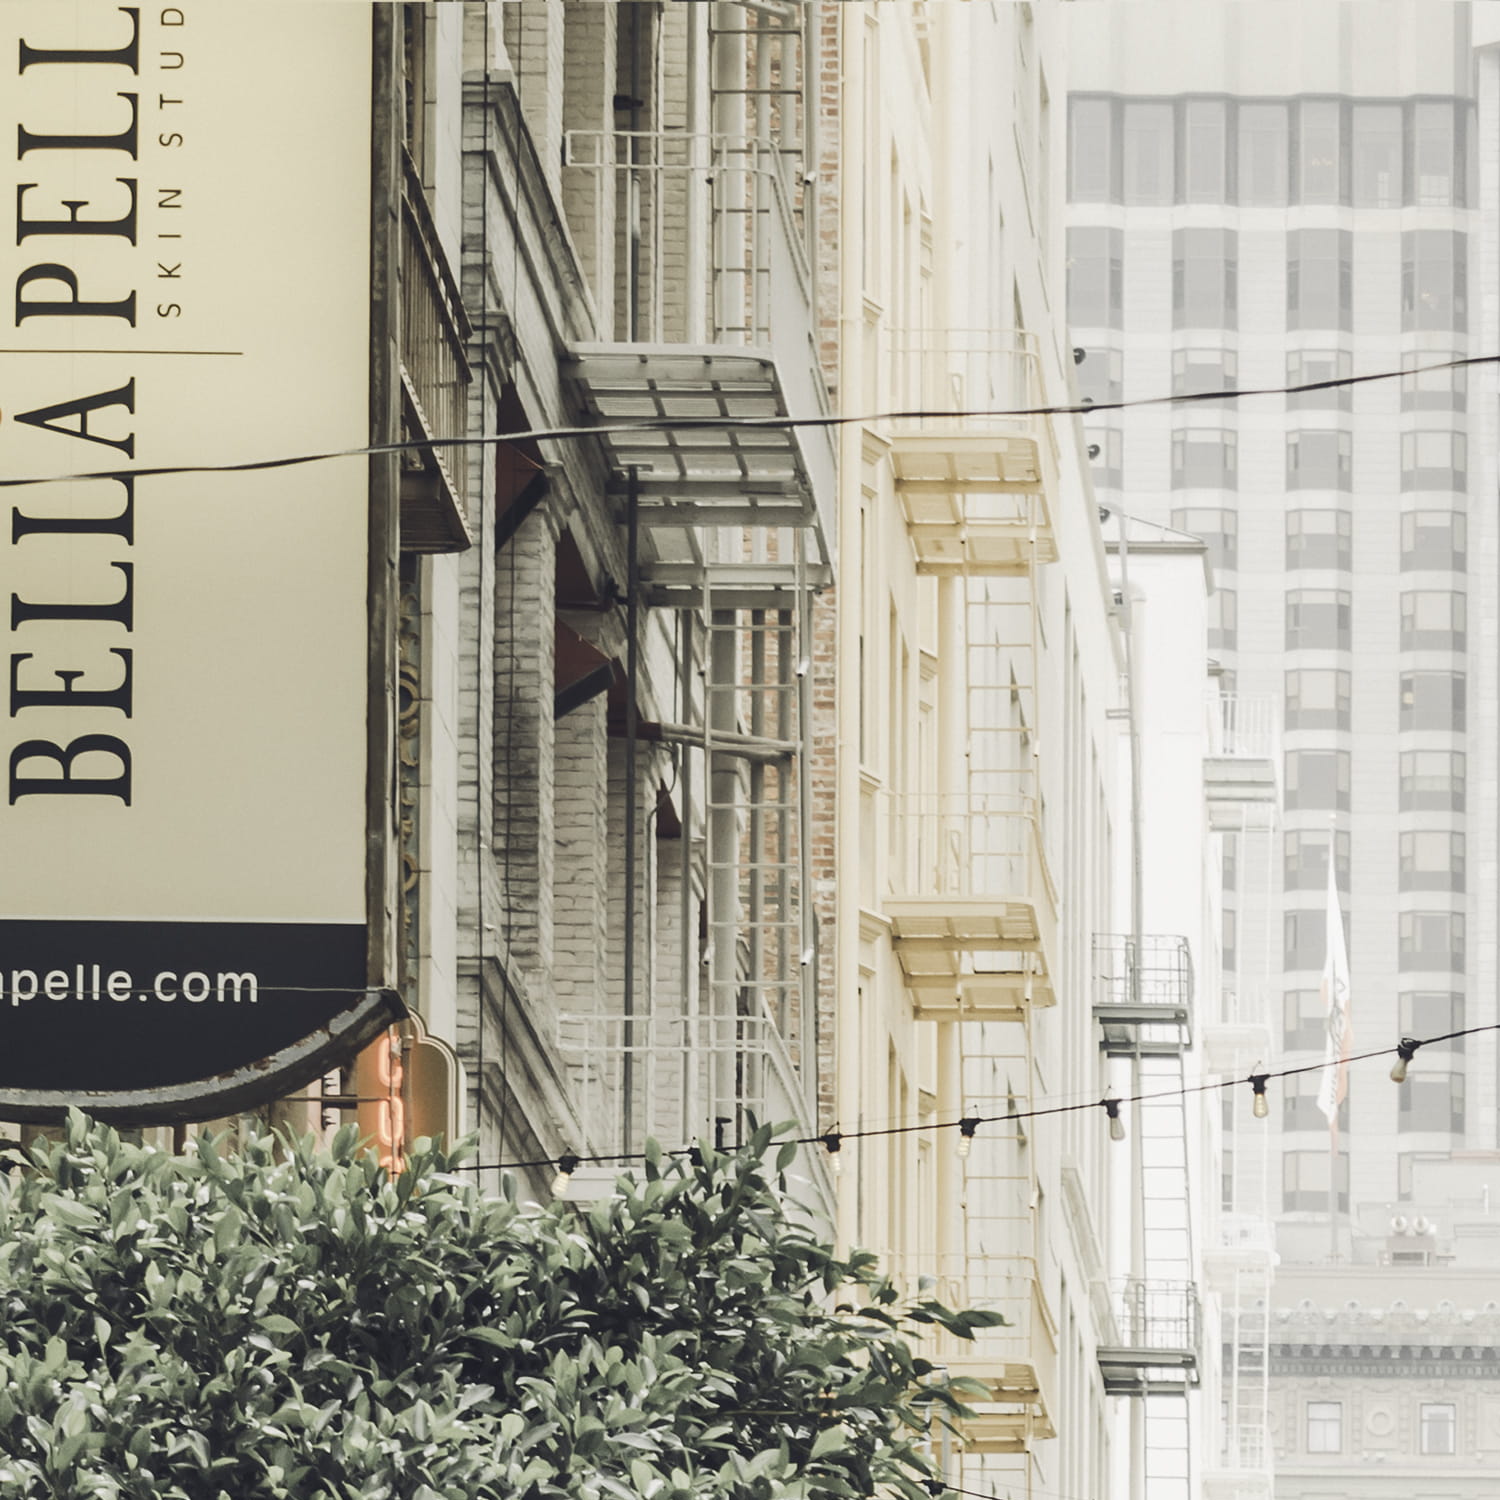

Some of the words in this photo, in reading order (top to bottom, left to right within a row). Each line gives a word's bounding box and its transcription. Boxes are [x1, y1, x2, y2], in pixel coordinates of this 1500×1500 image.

[156, 188, 182, 318] SKIN
[9, 376, 135, 806] BELLA
[0, 964, 259, 1006] pelle.com
